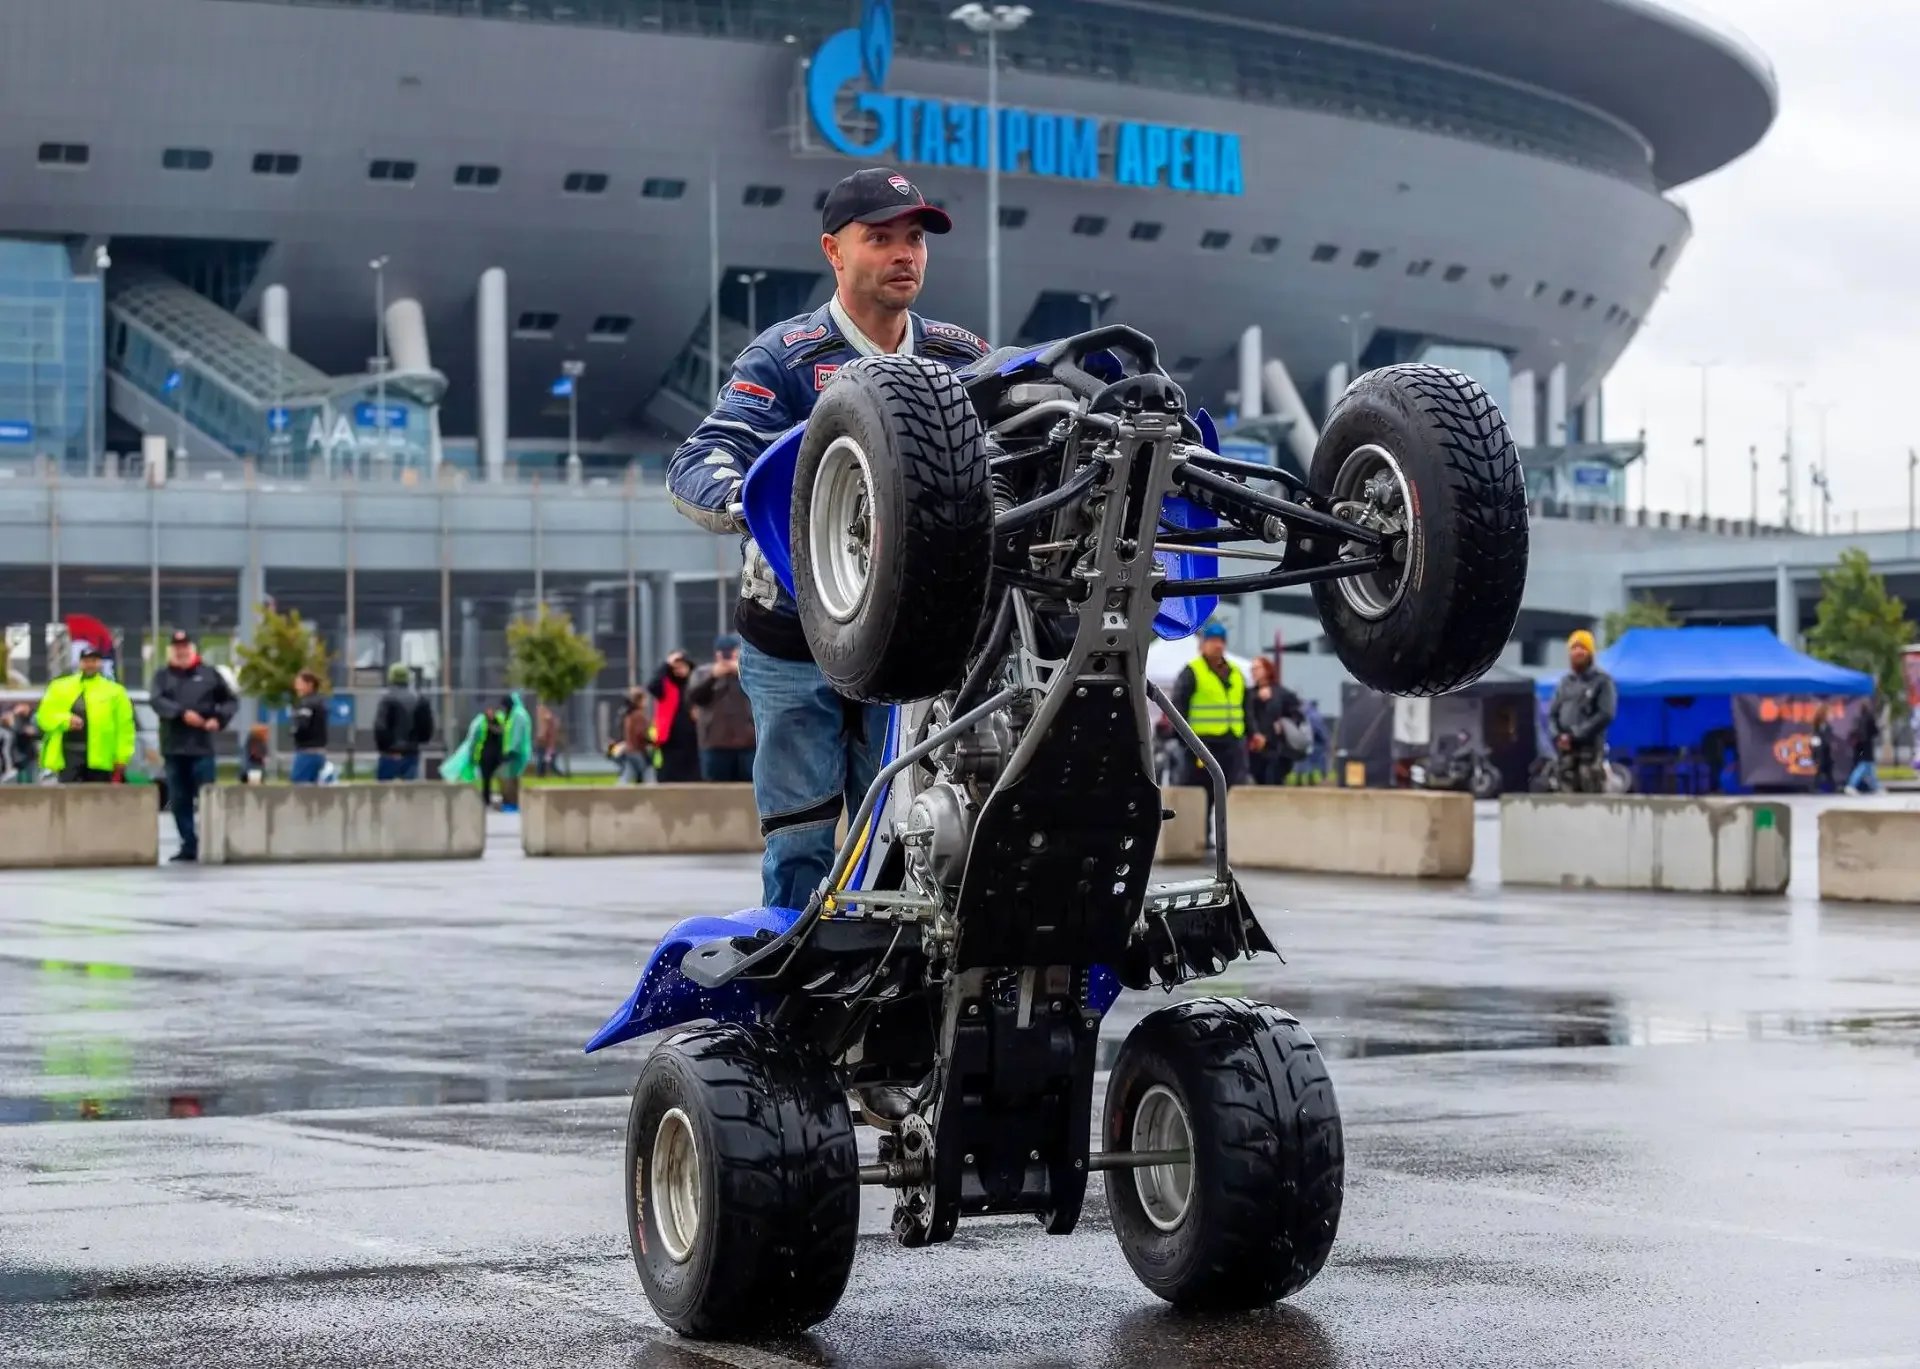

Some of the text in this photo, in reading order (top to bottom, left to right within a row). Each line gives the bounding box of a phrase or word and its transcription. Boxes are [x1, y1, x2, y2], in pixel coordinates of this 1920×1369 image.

[900, 96, 1244, 195] ГАЗПРОМ АРЕНА
[931, 326, 982, 347] MOTUL
